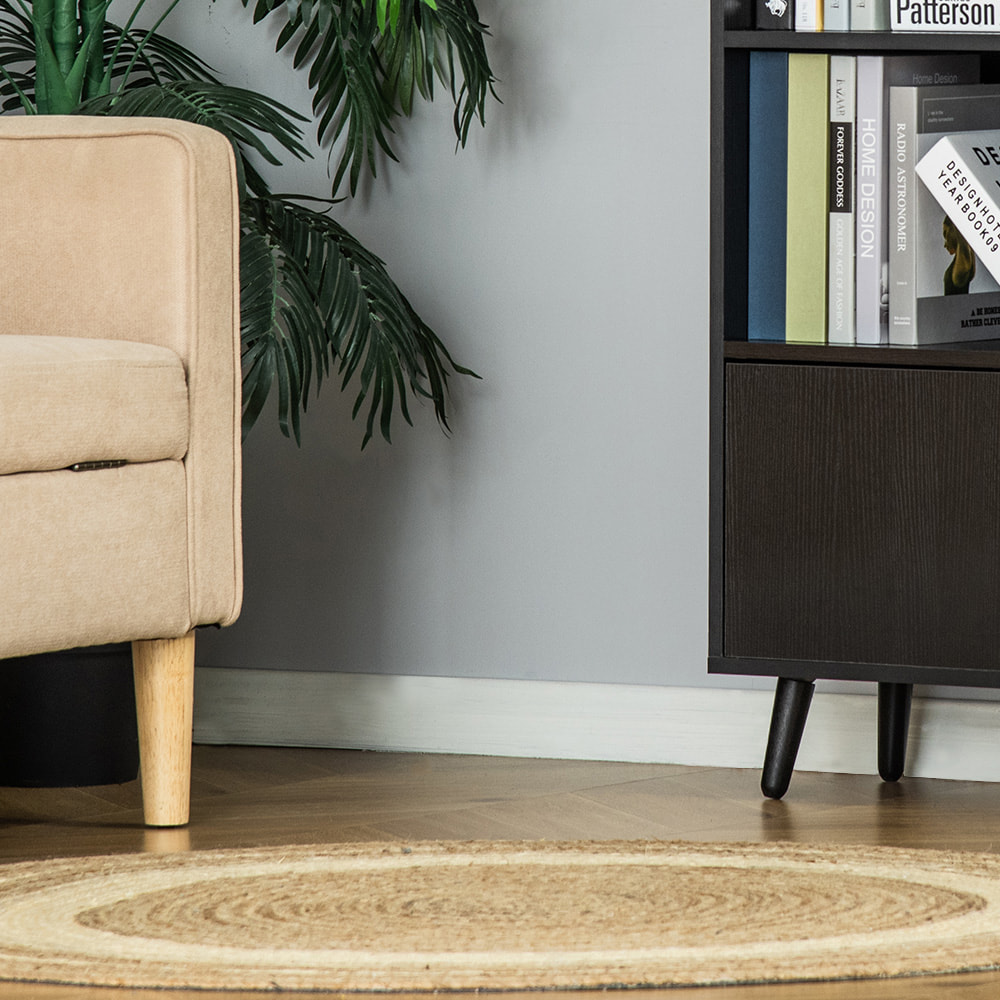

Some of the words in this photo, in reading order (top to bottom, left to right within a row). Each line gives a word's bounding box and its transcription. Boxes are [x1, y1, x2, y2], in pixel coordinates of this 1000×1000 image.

[912, 73, 933, 84] Home
[862, 118, 876, 177] HOME
[897, 123, 906, 162] RADIO
[836, 166, 844, 208] GODDESS
[897, 167, 906, 252] ASTRONOMER
[961, 319, 983, 328] RATHER
